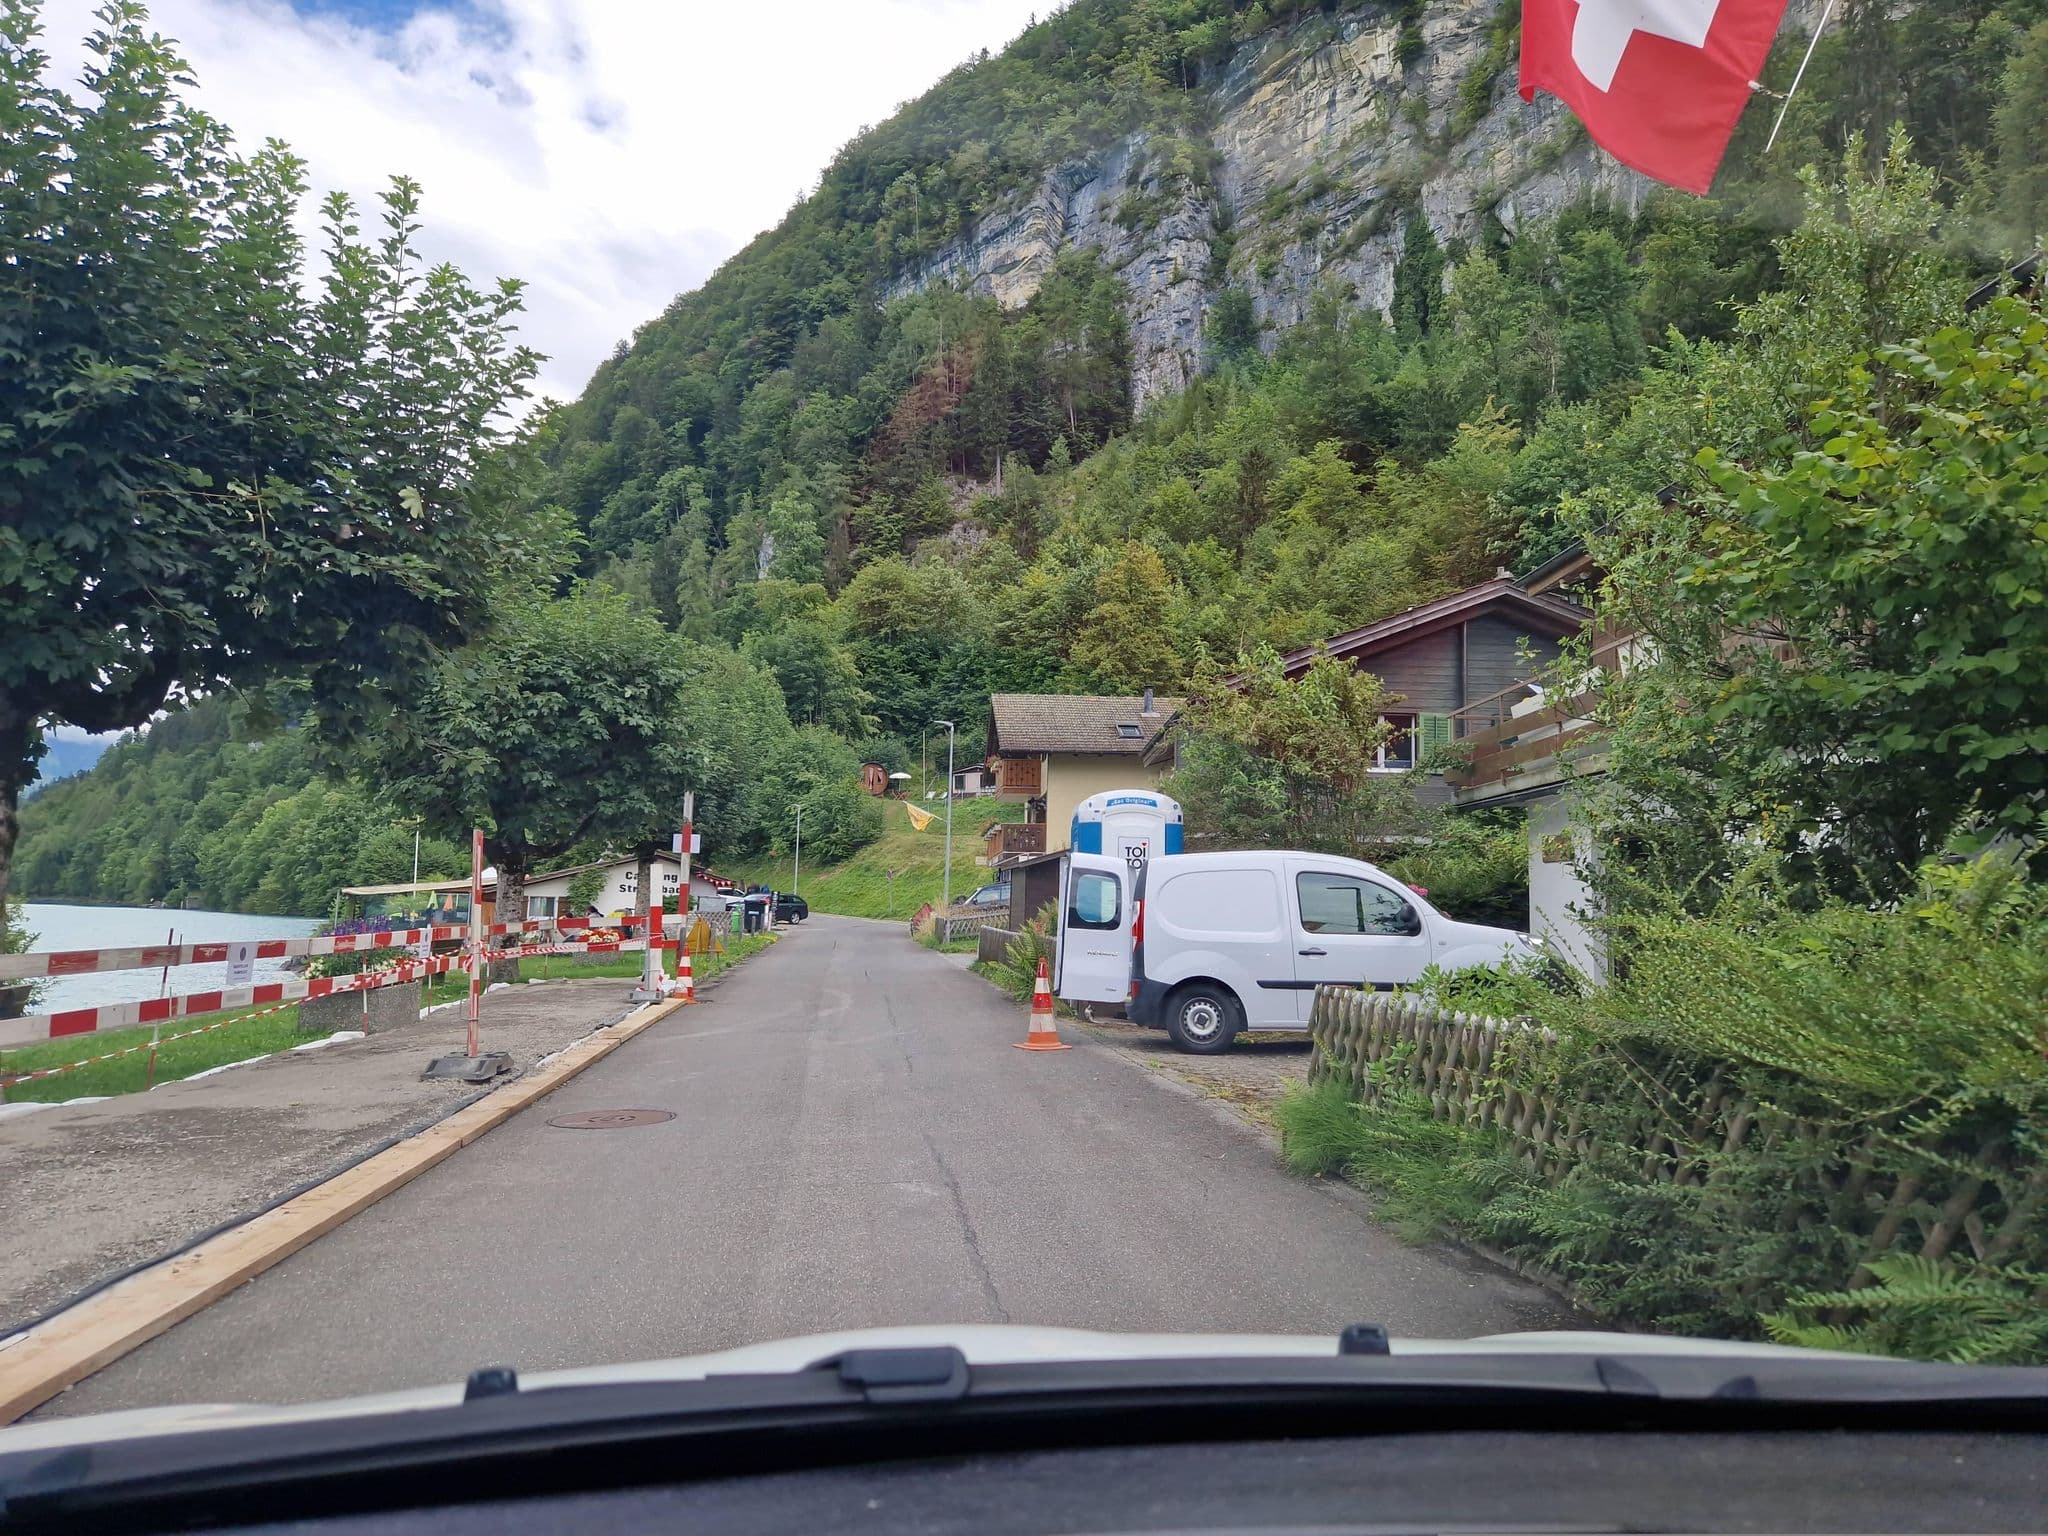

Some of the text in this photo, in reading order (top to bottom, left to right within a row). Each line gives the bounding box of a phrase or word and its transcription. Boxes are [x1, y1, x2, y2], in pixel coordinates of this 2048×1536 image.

[1125, 846, 1146, 858] TOI
[1125, 858, 1146, 870] TO
[625, 871, 678, 883] Cang
